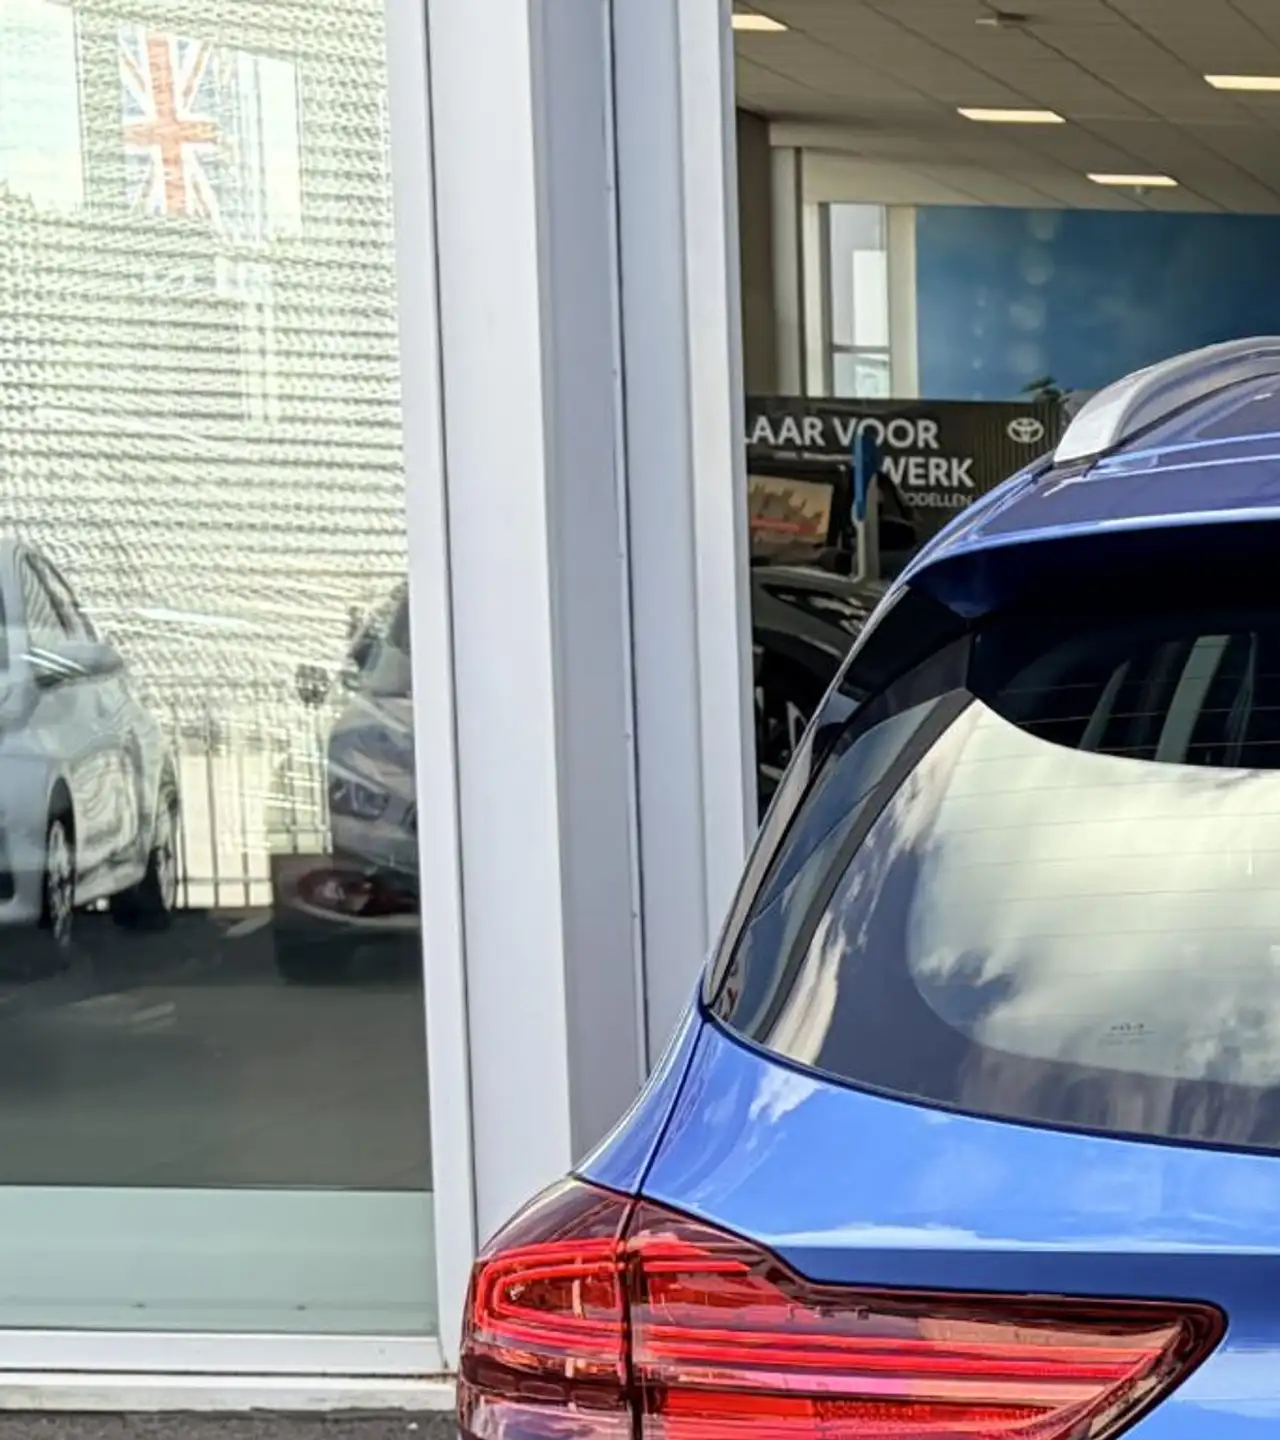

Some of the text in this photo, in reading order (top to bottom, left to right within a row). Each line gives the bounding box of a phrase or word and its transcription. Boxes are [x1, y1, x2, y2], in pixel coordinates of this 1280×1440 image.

[744, 415, 940, 450] AAR VOOR
[881, 455, 976, 488] WERK
[903, 491, 973, 508] ODELLEN
